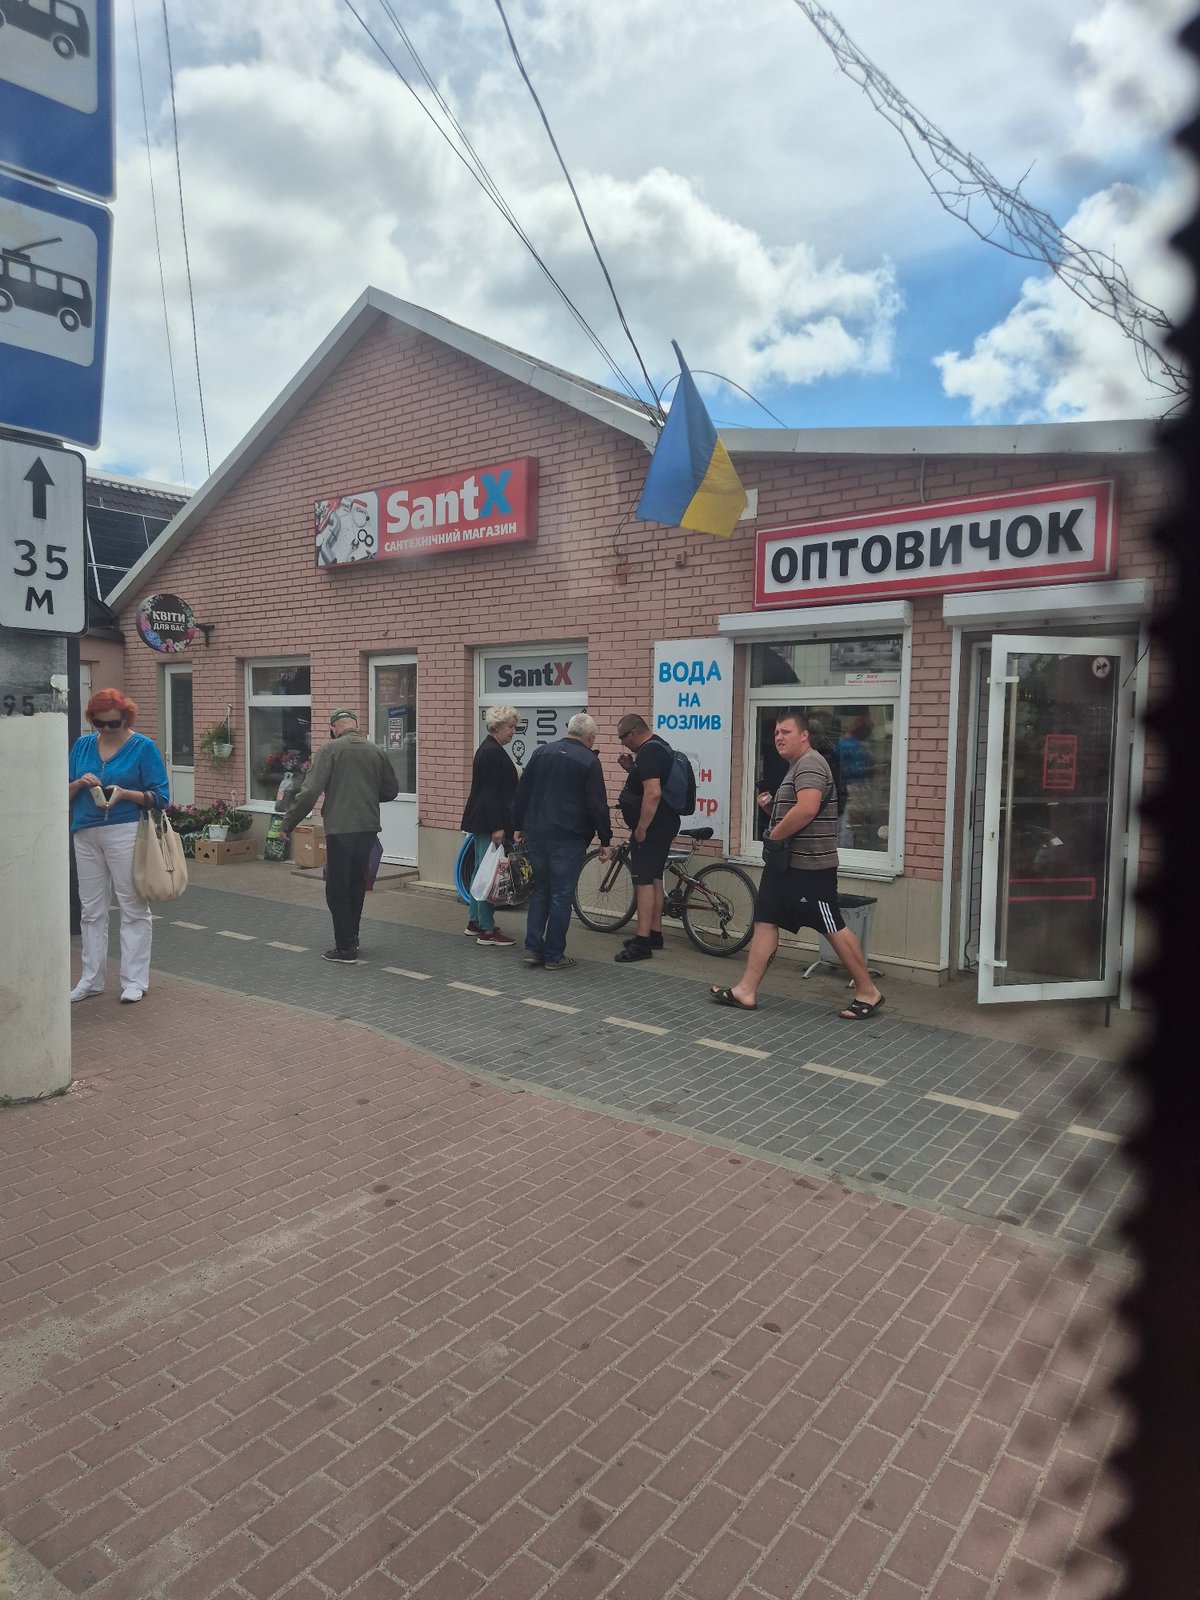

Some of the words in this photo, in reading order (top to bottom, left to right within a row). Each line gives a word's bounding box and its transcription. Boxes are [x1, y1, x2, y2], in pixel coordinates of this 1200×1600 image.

[386, 468, 513, 534] SantX
[384, 529, 461, 552] САНТЕХНІЧНИЙ
[462, 521, 517, 541] МАГАЗИН
[770, 508, 1084, 584] ОПТОВИЧОК
[13, 539, 69, 581] 35
[152, 610, 186, 623] КВІТИ
[153, 622, 170, 631] ДЛЯ
[170, 624, 185, 632] ВАС
[498, 661, 573, 688] SantX
[658, 660, 722, 685] ВОДА
[3, 694, 35, 717] 95
[678, 692, 701, 708] НА
[657, 714, 722, 731] РОЗЛИВ
[696, 797, 719, 817] тр
